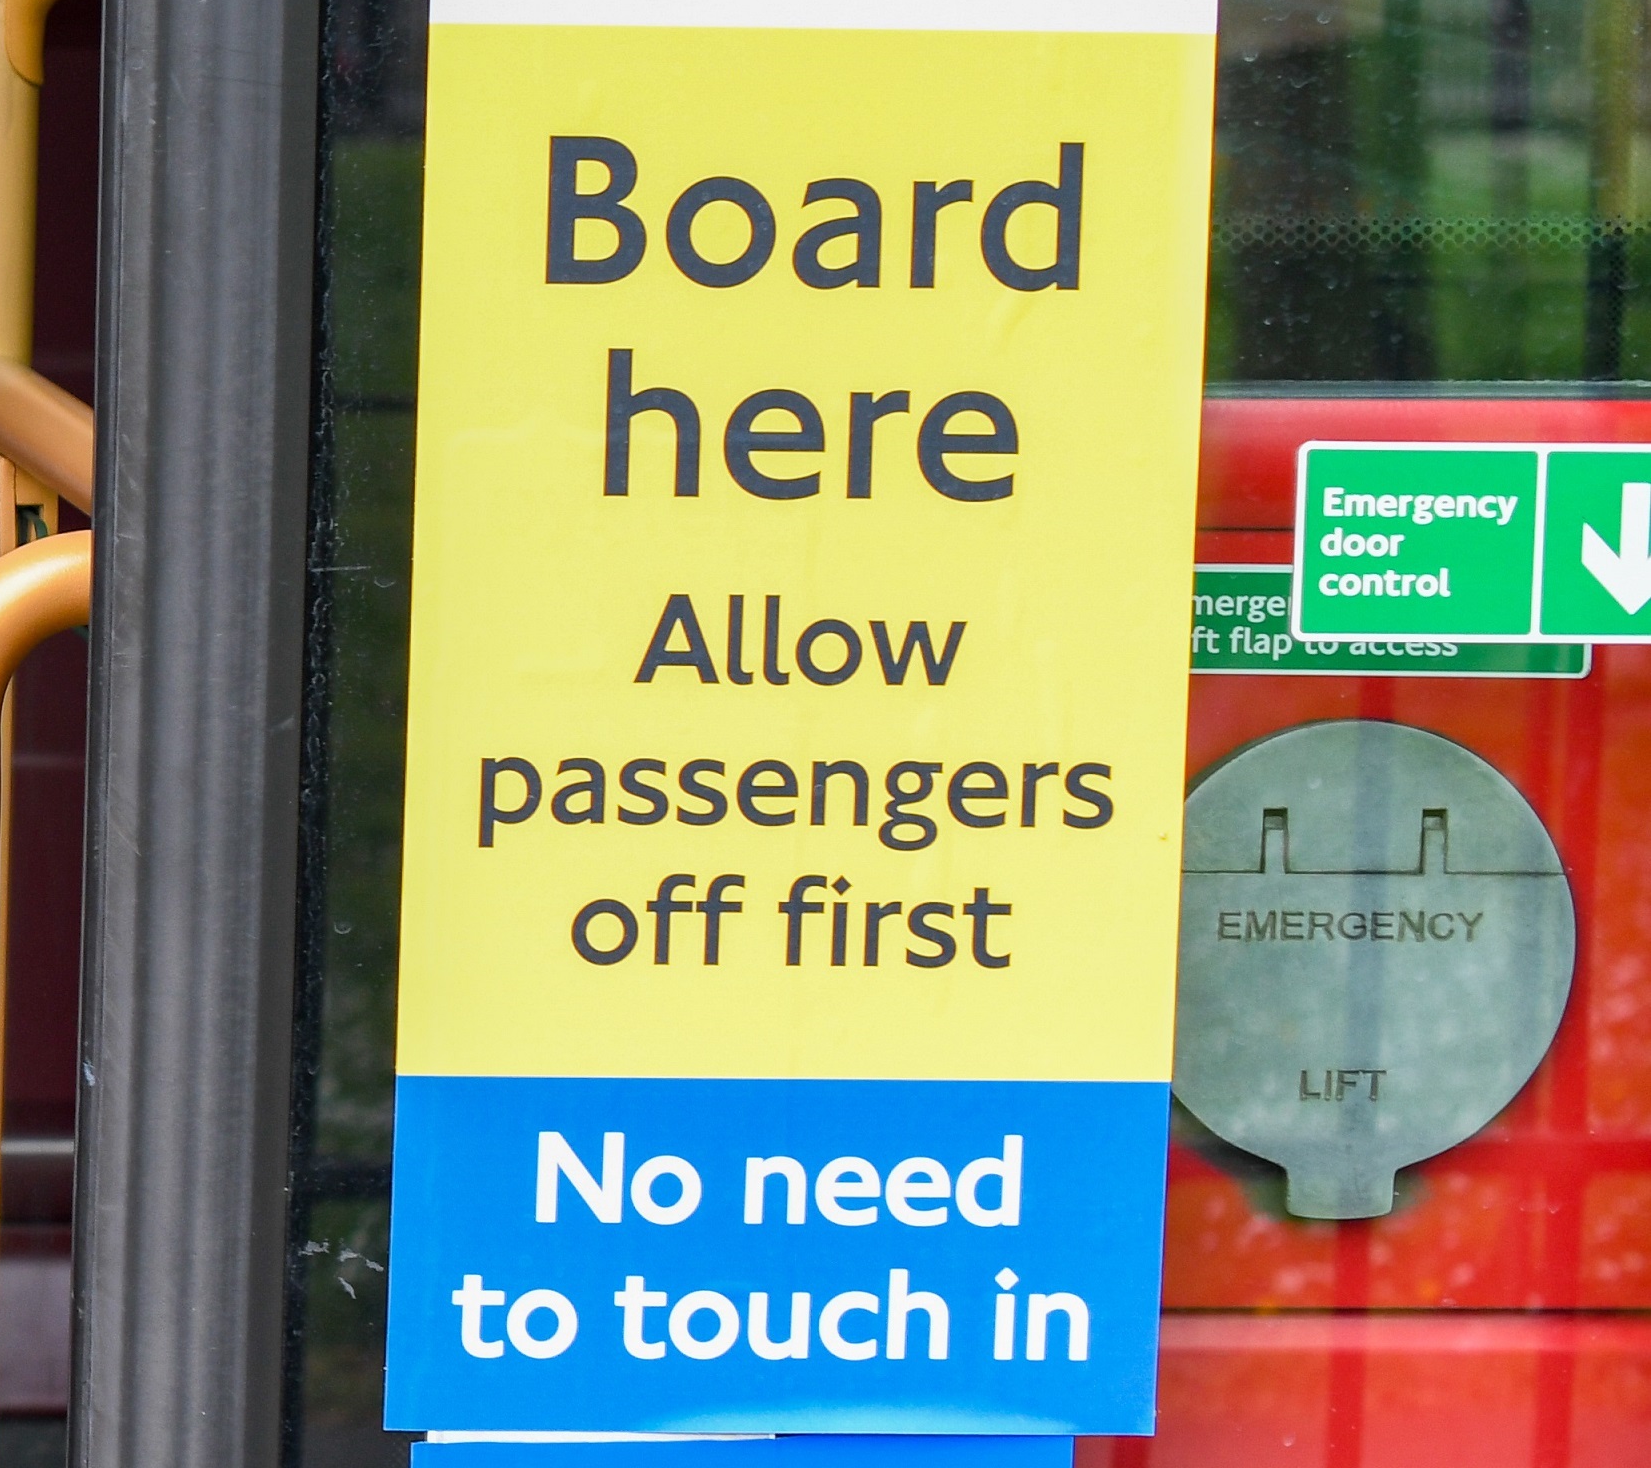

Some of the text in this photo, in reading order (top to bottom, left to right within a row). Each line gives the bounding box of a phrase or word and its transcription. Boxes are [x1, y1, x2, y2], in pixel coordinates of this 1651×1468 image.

[545, 136, 1084, 292] Board
[604, 348, 1018, 502] here
[1323, 487, 1518, 525] Emergency
[1320, 527, 1404, 557] door
[1193, 595, 1291, 623] merge
[1319, 568, 1451, 597] control
[634, 594, 966, 686] Allow
[1229, 626, 1292, 661] flap
[479, 757, 1113, 851] passengers
[571, 874, 1011, 969] off first
[1216, 910, 1484, 942] EMERGENCY
[1299, 1069, 1386, 1101] LIFT
[536, 1132, 1023, 1227] No need
[452, 1268, 1090, 1361] to touch in
